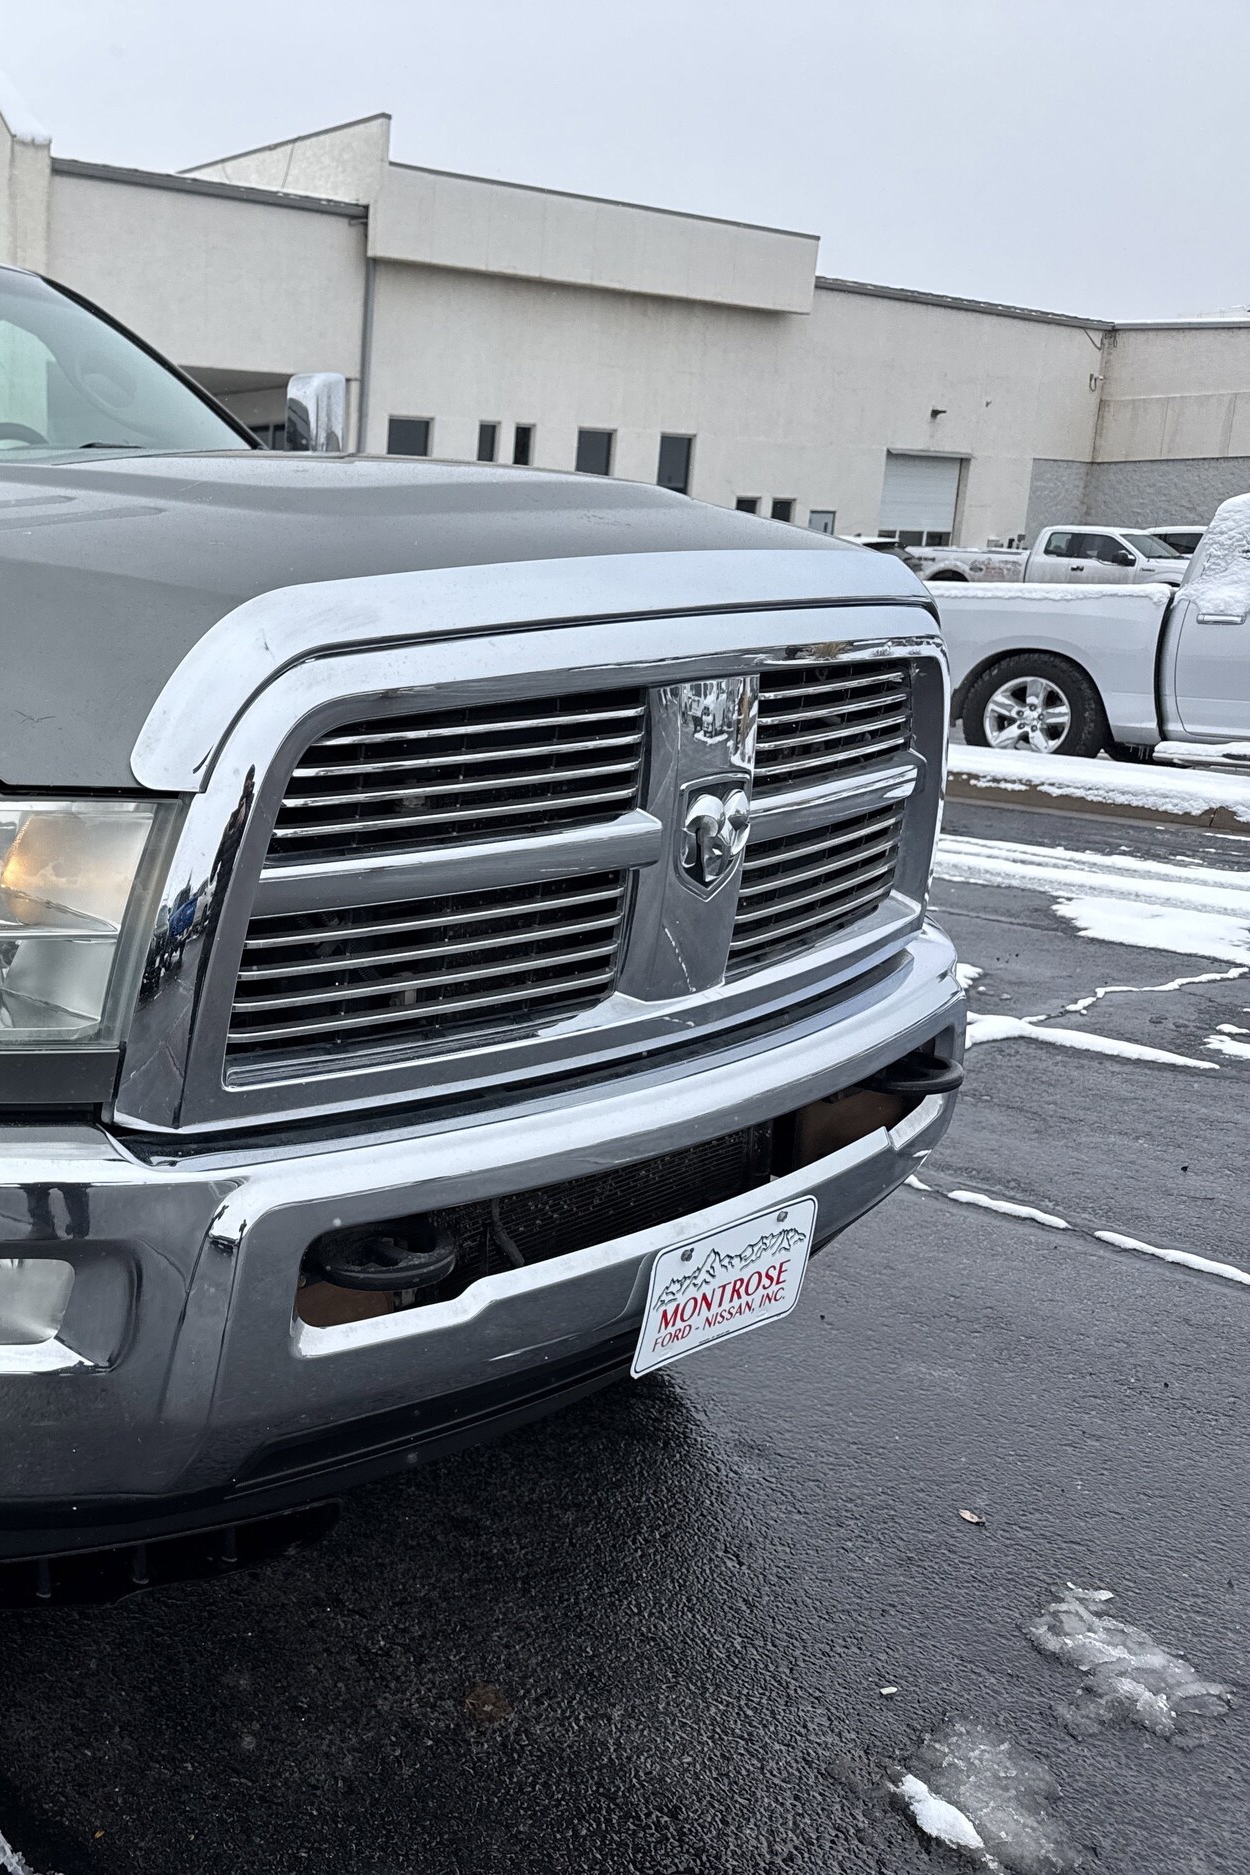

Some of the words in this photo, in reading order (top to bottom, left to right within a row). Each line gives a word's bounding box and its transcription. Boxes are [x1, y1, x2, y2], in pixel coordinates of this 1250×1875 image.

[652, 1324, 692, 1352] FORD
[702, 1299, 755, 1331] NISSAN,
[758, 1287, 785, 1307] INC.
[658, 1259, 791, 1334] MONTROSE
